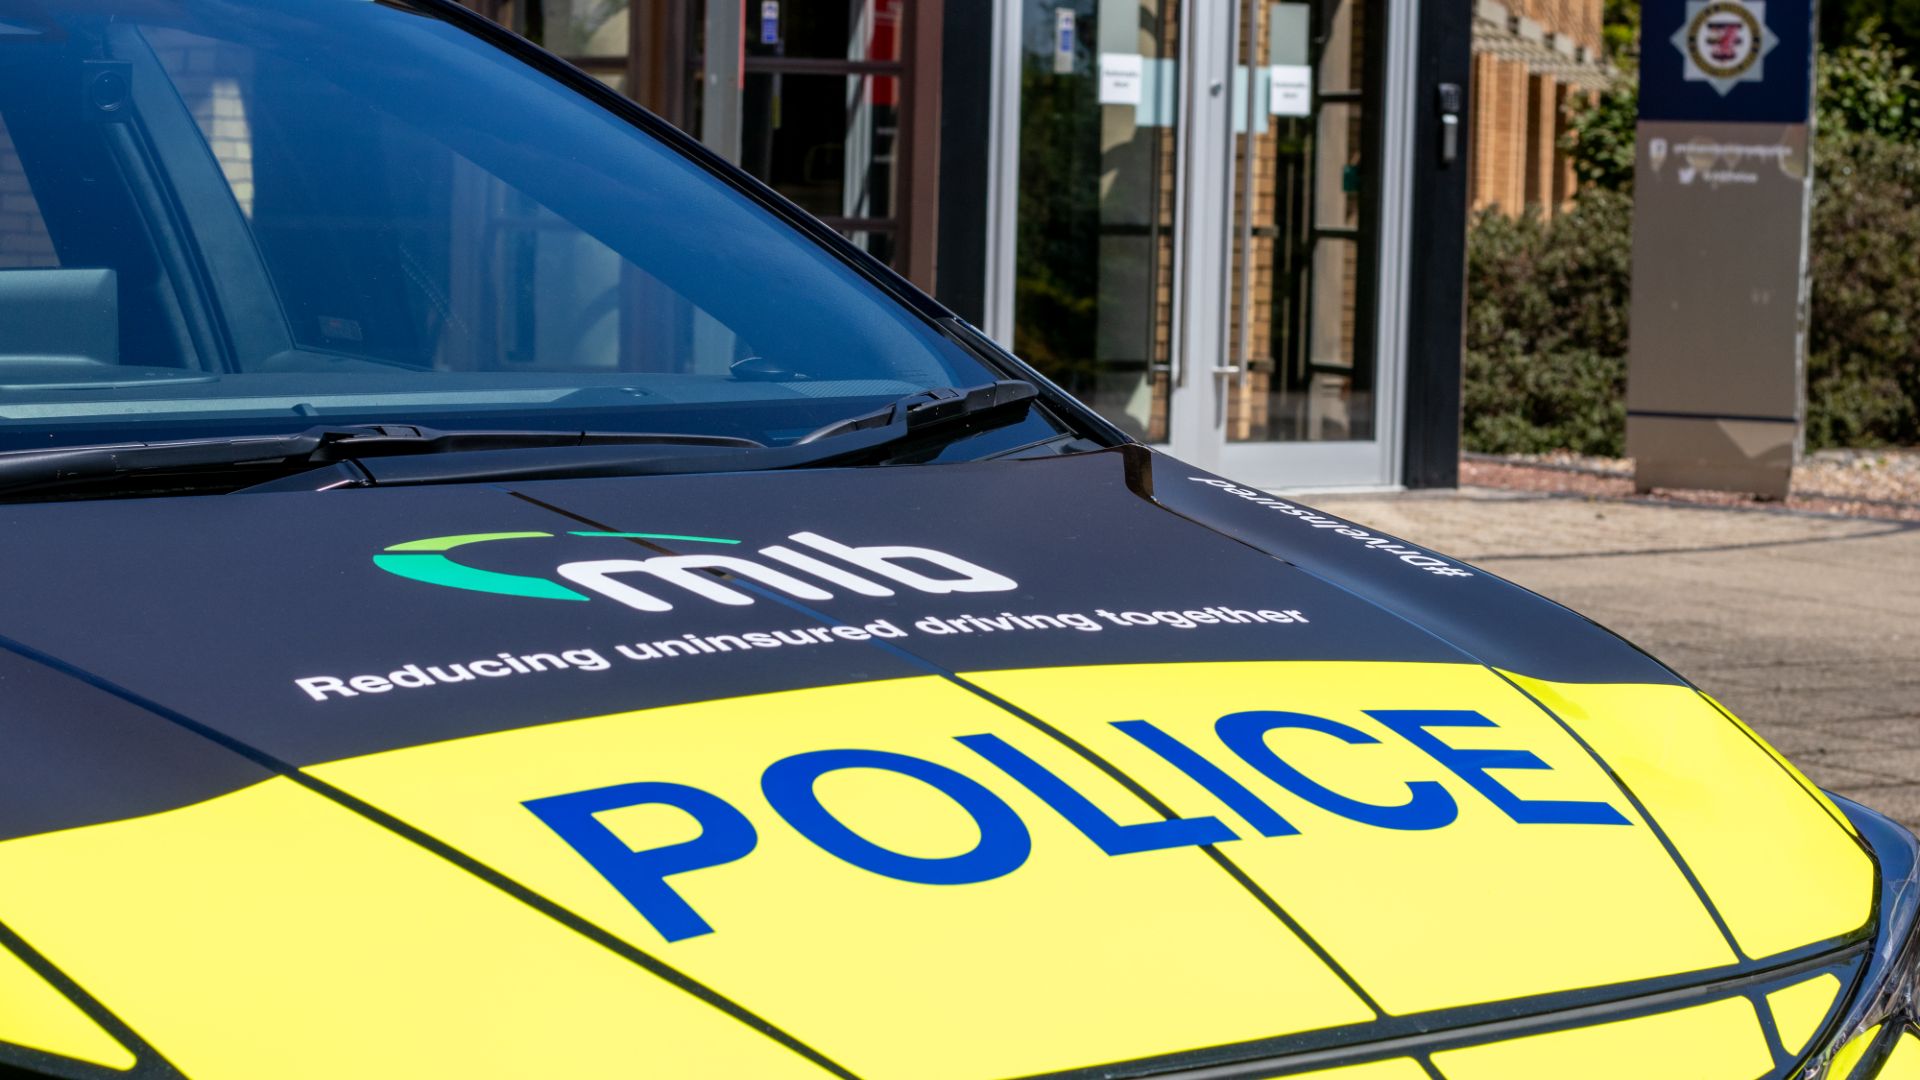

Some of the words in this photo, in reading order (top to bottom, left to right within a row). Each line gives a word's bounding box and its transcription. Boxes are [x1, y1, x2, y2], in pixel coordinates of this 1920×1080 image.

[556, 532, 1018, 612] mib
[1188, 476, 1474, 577] #DriveInsured
[295, 649, 611, 701] Reducing
[614, 619, 908, 660] uninsured
[914, 612, 1103, 635] driving
[1095, 606, 1310, 629] together
[519, 709, 1635, 943] POLICE
